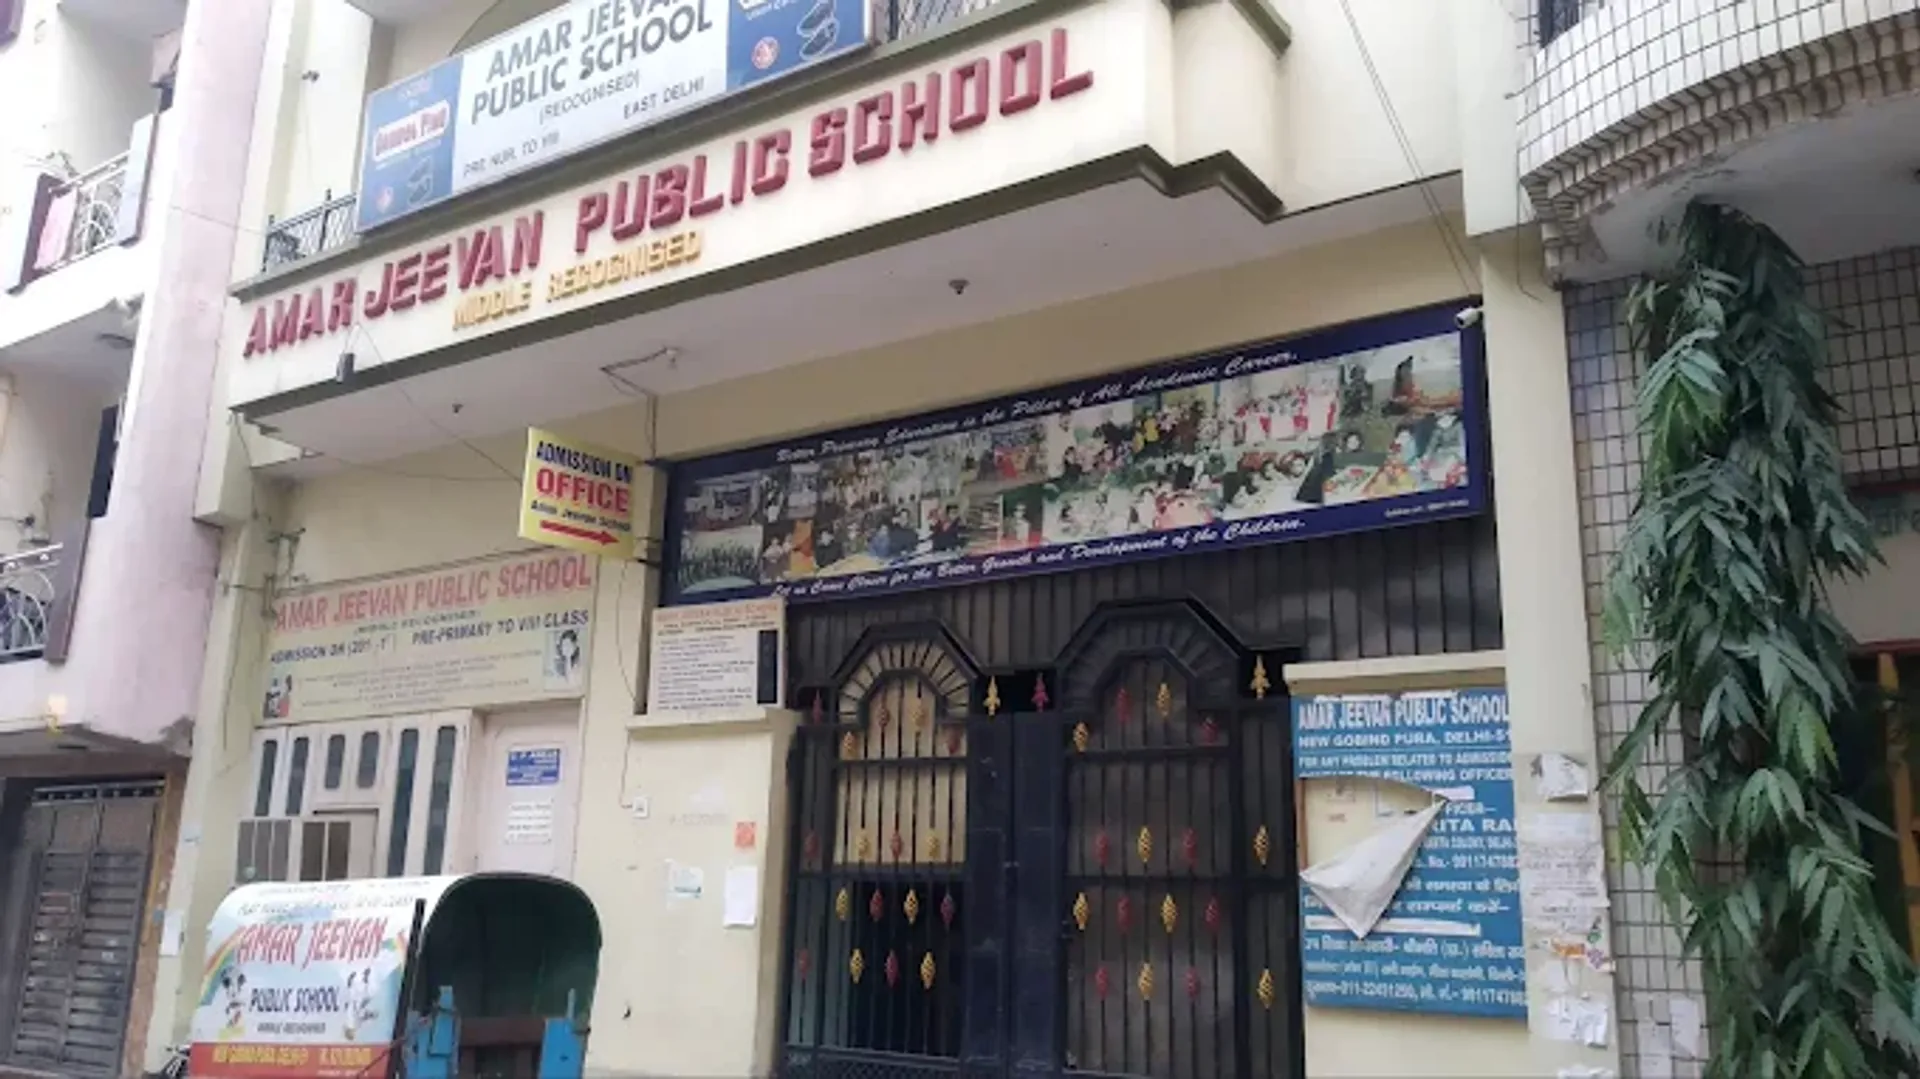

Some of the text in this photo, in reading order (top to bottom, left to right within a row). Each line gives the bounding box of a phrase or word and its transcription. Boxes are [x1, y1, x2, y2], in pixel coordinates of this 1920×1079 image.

[471, 0, 713, 125] PUBLIC SCHOOL
[487, 0, 682, 82] AMAR JEEV
[539, 70, 640, 124] (RECOGNISED)
[623, 77, 704, 119] EAST DELHI
[523, 140, 537, 155] TO
[242, 278, 356, 358] AMAR
[364, 210, 544, 320] JEEVAN
[575, 128, 791, 254] PUBLIC
[808, 27, 1094, 178] SCHOOL
[452, 231, 704, 331] MIDDLE RECOGNISED
[821, 437, 880, 456] Primary
[883, 420, 959, 446] Education
[981, 406, 1006, 425] the
[1067, 390, 1087, 408] of
[1089, 382, 1124, 400] All
[1126, 365, 1220, 394] Academic
[536, 440, 612, 479] ADMISSION
[536, 468, 630, 514] OFFICE
[889, 569, 911, 587] for
[912, 566, 933, 581] the
[980, 551, 1034, 575] Growth
[1035, 548, 1065, 564] and
[1070, 535, 1169, 560] Development
[1171, 532, 1190, 549] of
[1192, 526, 1220, 544] the
[275, 553, 593, 633] AMAR JEEVAN PUBLIC SCHOOL
[411, 623, 493, 646] PRE-PRIMARY
[497, 617, 515, 634] TO
[544, 608, 590, 630] CLASS
[270, 645, 327, 664] ADMISSION
[1299, 693, 1512, 730] AMAR JEEVAN PUBLIC SCHOOL
[1299, 734, 1330, 748] NEW
[1333, 731, 1391, 748] GOBIND
[1299, 756, 1319, 769] FOR
[1320, 755, 1341, 769] ANY
[1341, 752, 1391, 768] PROBLEM
[1392, 752, 1436, 767] RELATED
[1438, 752, 1453, 766] TO
[235, 917, 389, 970] AMAR JEEVAN
[248, 986, 341, 1014] PUBLIC SCHOOL
